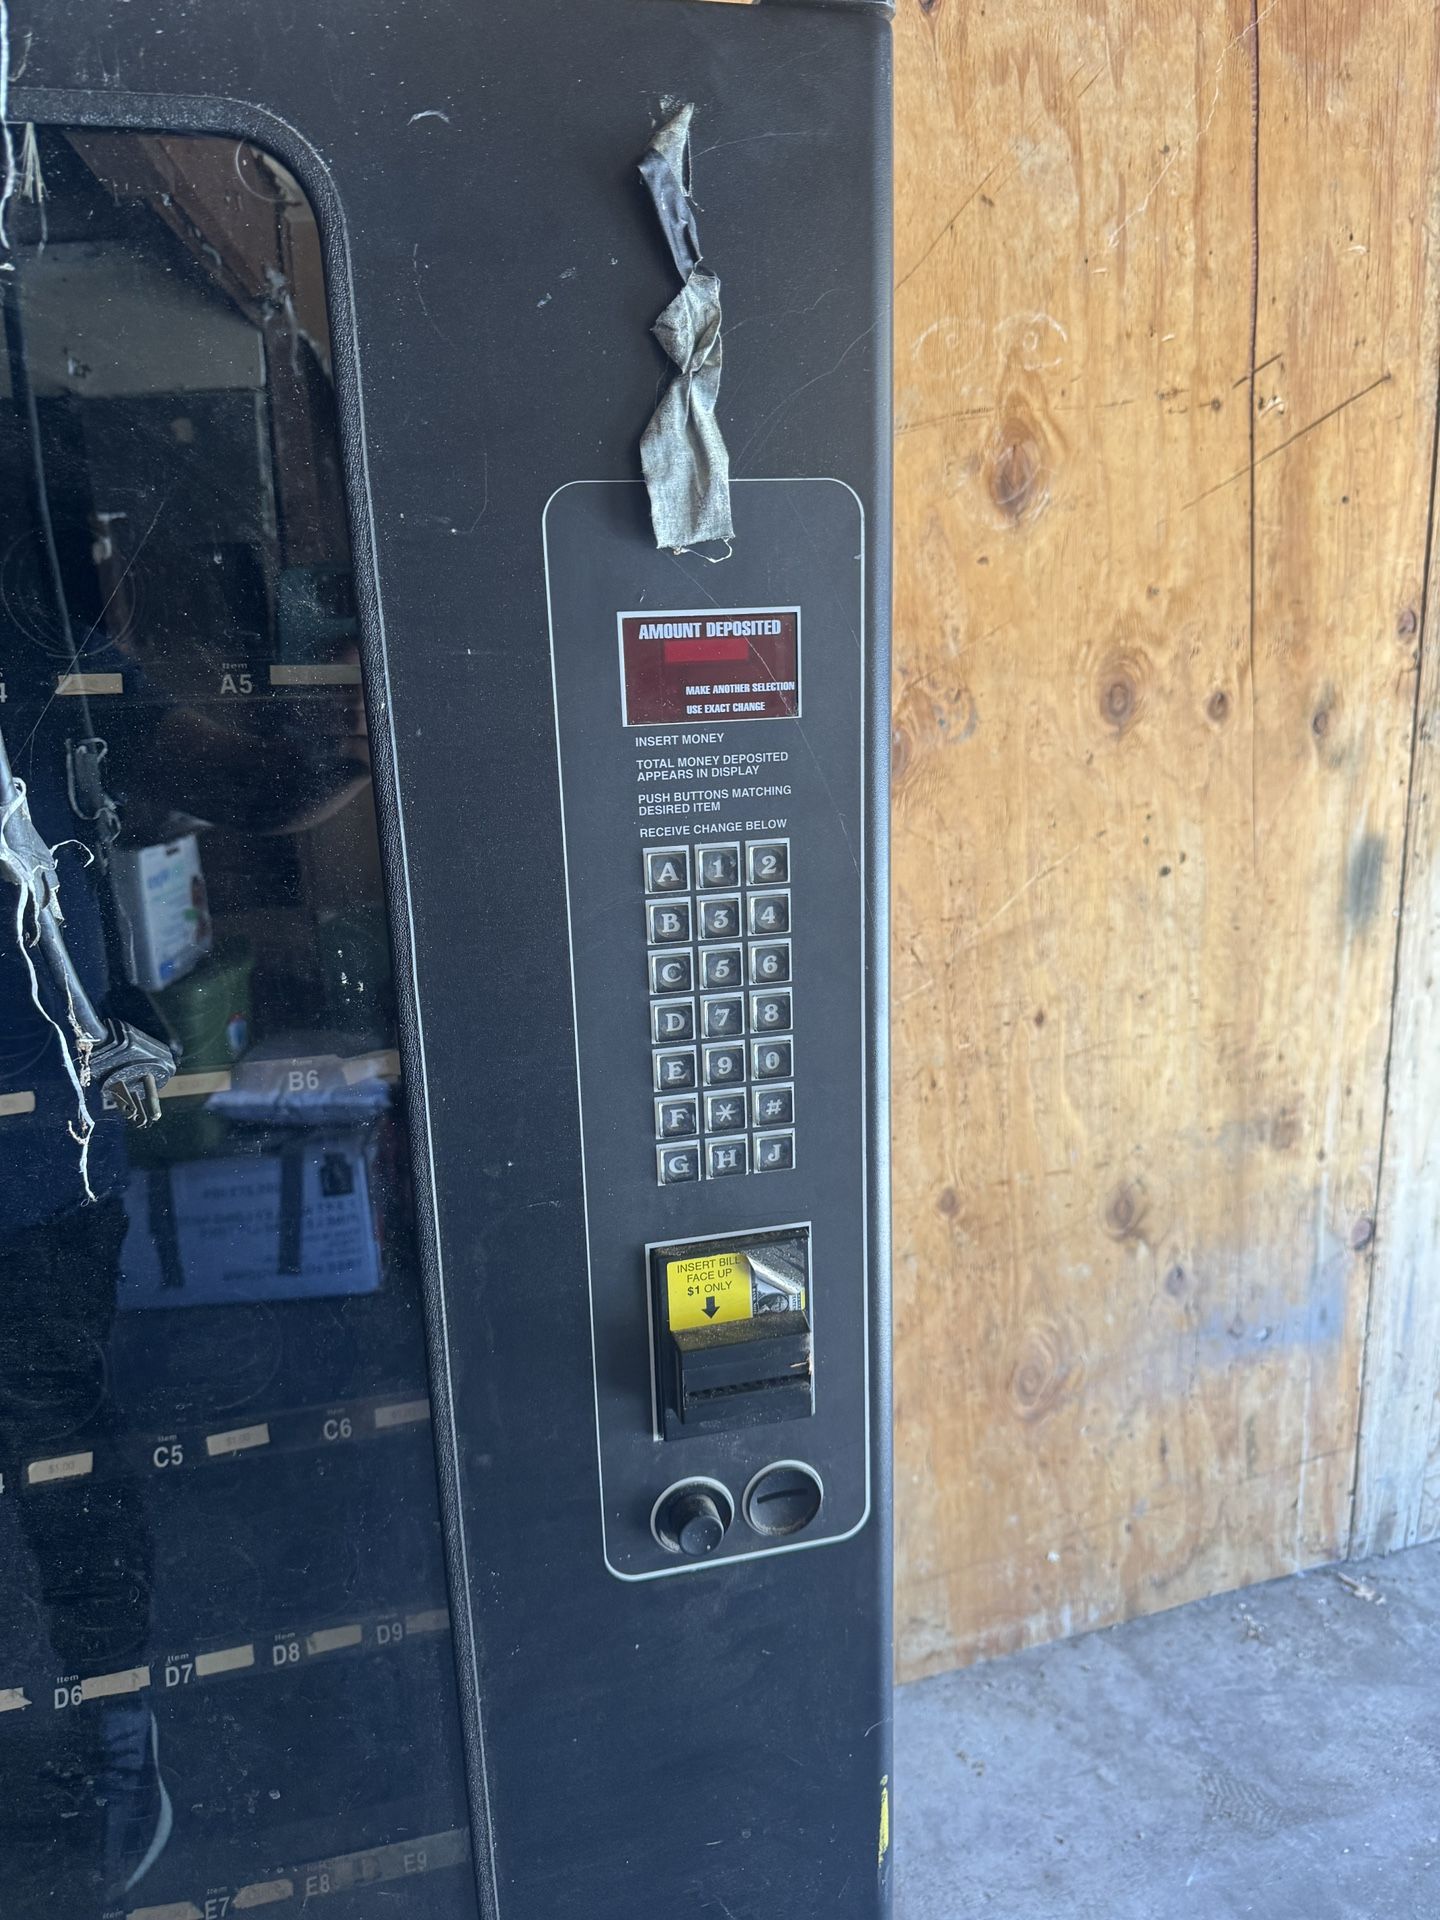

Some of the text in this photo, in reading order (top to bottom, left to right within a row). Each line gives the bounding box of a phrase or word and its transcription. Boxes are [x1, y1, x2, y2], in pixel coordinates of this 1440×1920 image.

[638, 619, 781, 640] AMOUNT DEPOSITED
[220, 674, 253, 694] A5
[685, 681, 795, 696] MAKE ANOTHER SELECTION
[686, 701, 765, 715] USE EXACT CHANGE
[635, 733, 725, 747] INSERT MONEY
[636, 752, 788, 770] TOTAL MONEY DEPOSITED
[637, 765, 760, 782] APPEARS IN DISPLAY
[638, 785, 792, 804] PUSH BUTTONS MATCHING
[639, 801, 721, 816] DESIRED ITEM
[640, 818, 787, 838] RECEIVE CHANGE BELOW
[658, 855, 777, 883] A 1 2
[661, 905, 776, 933] B 3 4
[661, 955, 778, 982] C 5 6
[665, 1003, 780, 1032] D 7 8
[667, 1051, 780, 1080] E 9 0
[288, 1070, 320, 1091] B6
[669, 1107, 688, 1128] F
[766, 1098, 783, 1116] #
[669, 1143, 782, 1175] G H J
[676, 1256, 740, 1274] INSERT BILL
[687, 1268, 732, 1283] FACE UP
[687, 1280, 733, 1296] $1 ONLY
[323, 1418, 352, 1440] C6
[153, 1444, 184, 1468] C5
[377, 1622, 404, 1645] D9
[272, 1642, 300, 1666] D8
[56, 1674, 79, 1683] Item
[165, 1663, 193, 1687] D7
[54, 1685, 82, 1710] D6
[403, 1851, 428, 1874] E9
[305, 1873, 331, 1897] E8
[204, 1896, 231, 1920] E7
